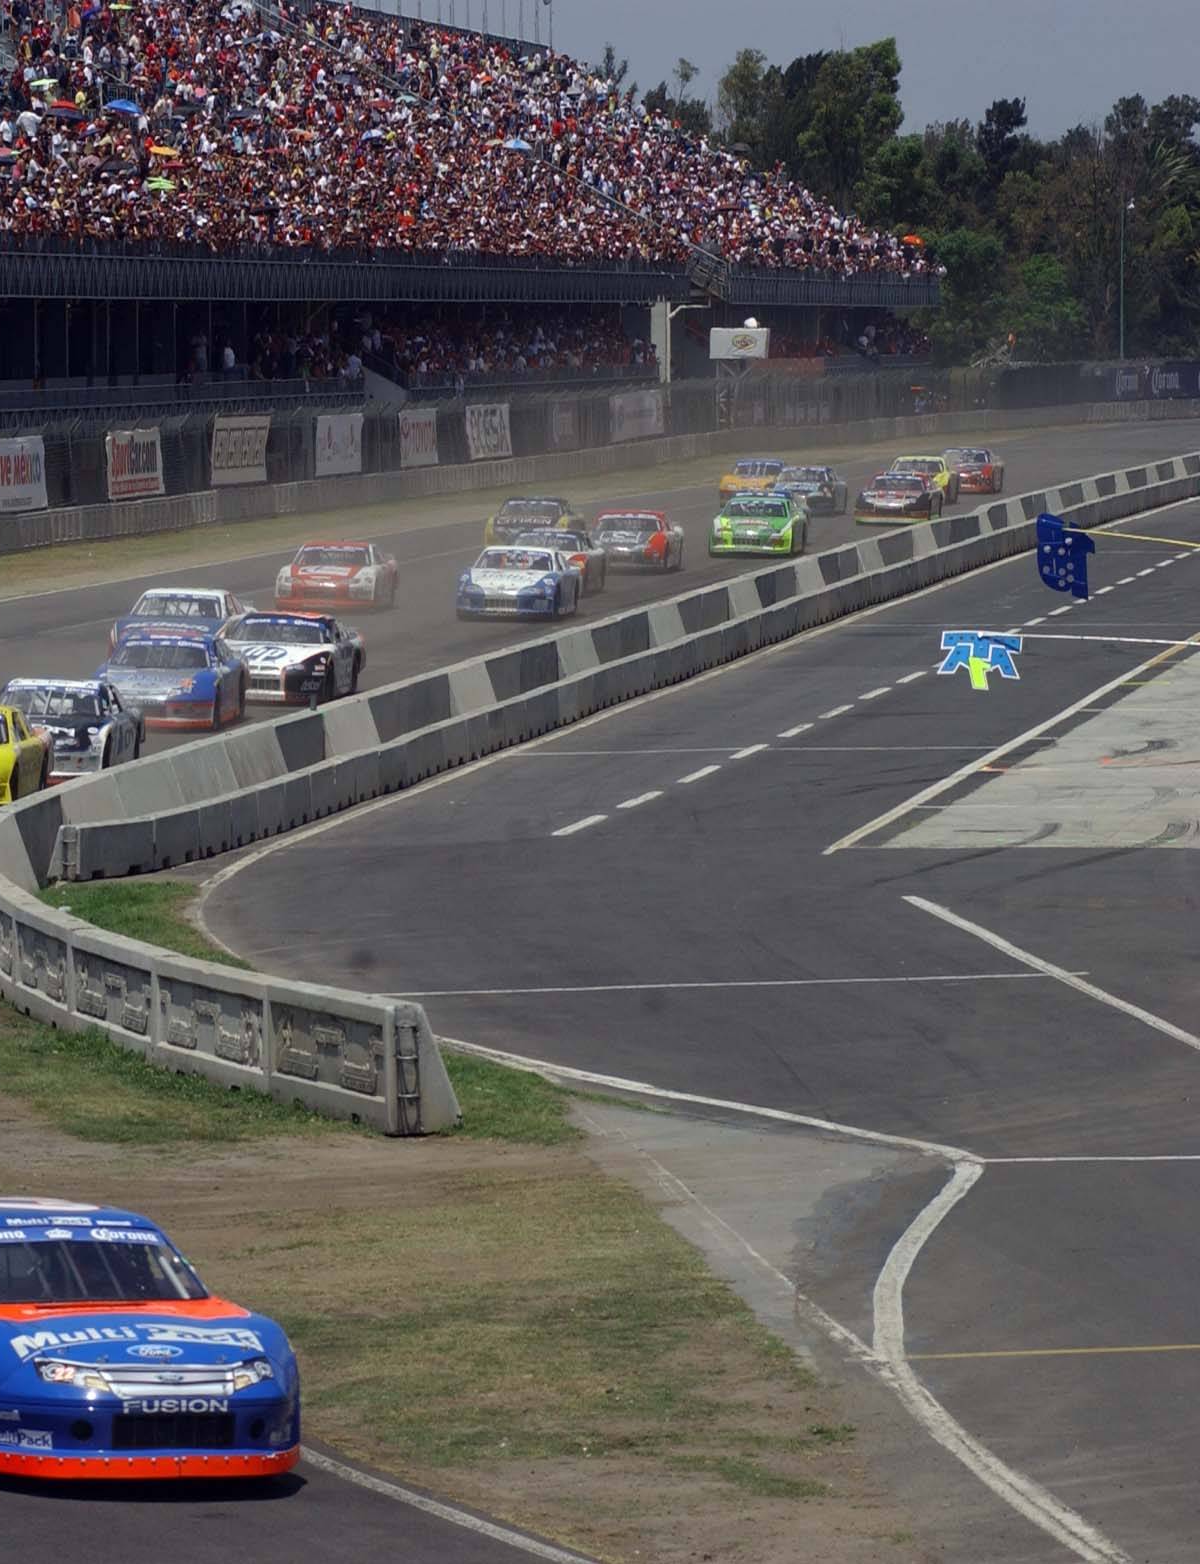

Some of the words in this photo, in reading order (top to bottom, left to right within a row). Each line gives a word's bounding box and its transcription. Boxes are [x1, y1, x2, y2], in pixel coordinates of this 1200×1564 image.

[90, 1228, 159, 1242] Corona
[10, 1326, 137, 1358] Multi
[54, 1366, 76, 1381] 22
[123, 1399, 229, 1414] FUSION
